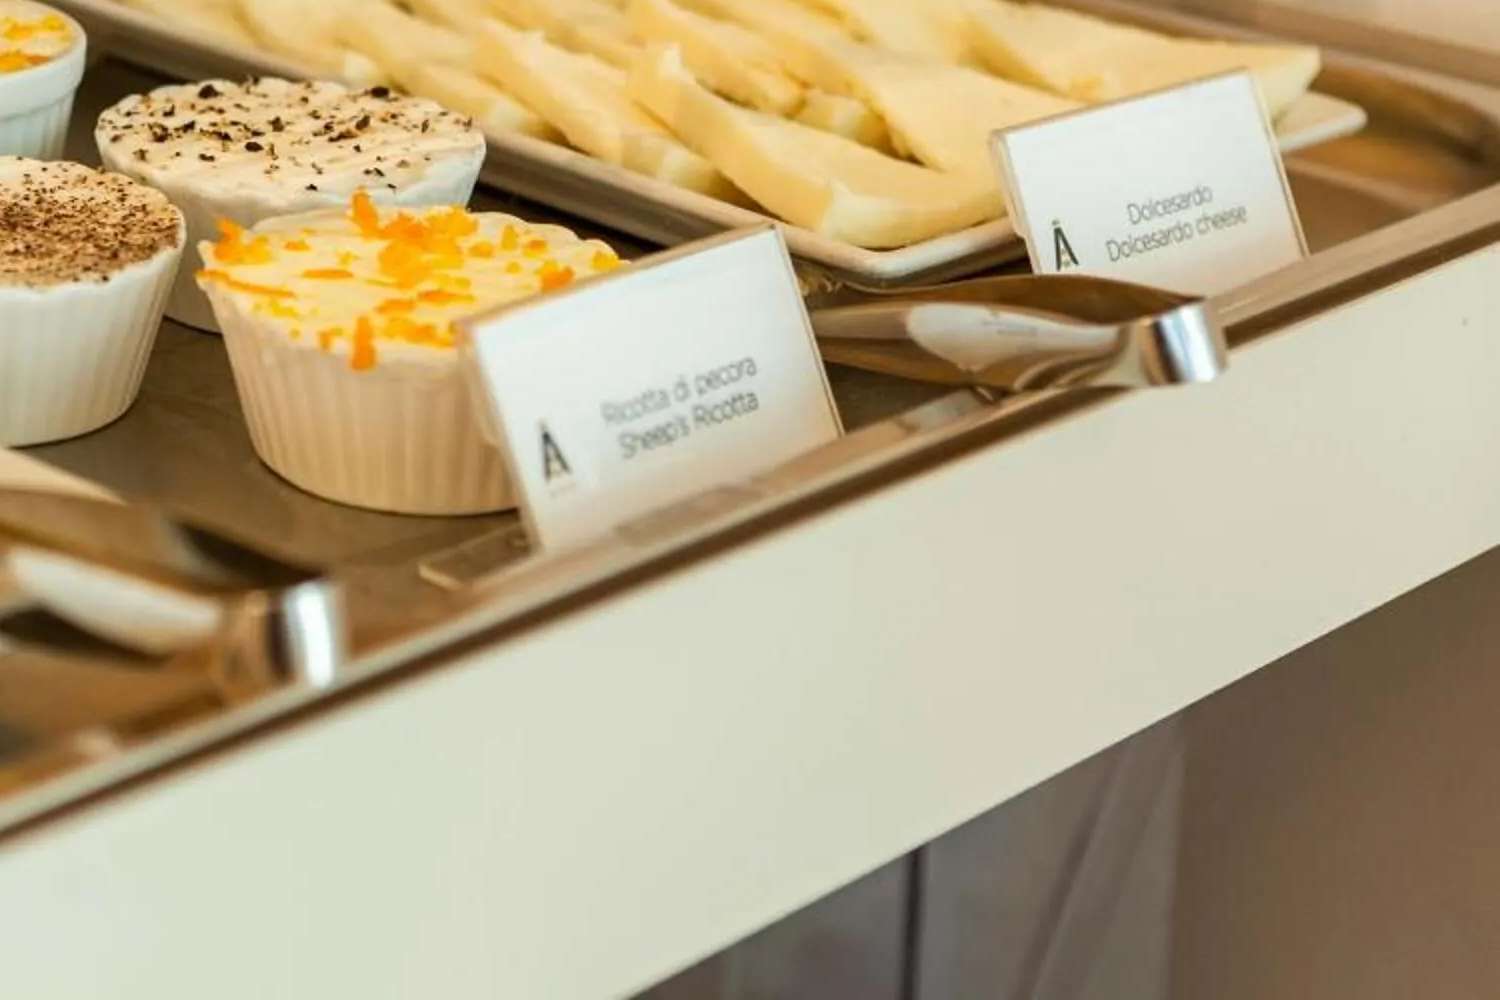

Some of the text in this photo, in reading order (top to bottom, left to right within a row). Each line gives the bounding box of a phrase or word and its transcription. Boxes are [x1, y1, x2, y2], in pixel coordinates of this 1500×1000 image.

[1105, 205, 1247, 262] Dolcesardo cheese
[1126, 185, 1213, 225] Dolcesardo
[601, 355, 757, 427] Ricotta di pecora
[616, 390, 759, 460] Sheep's Ricotta
